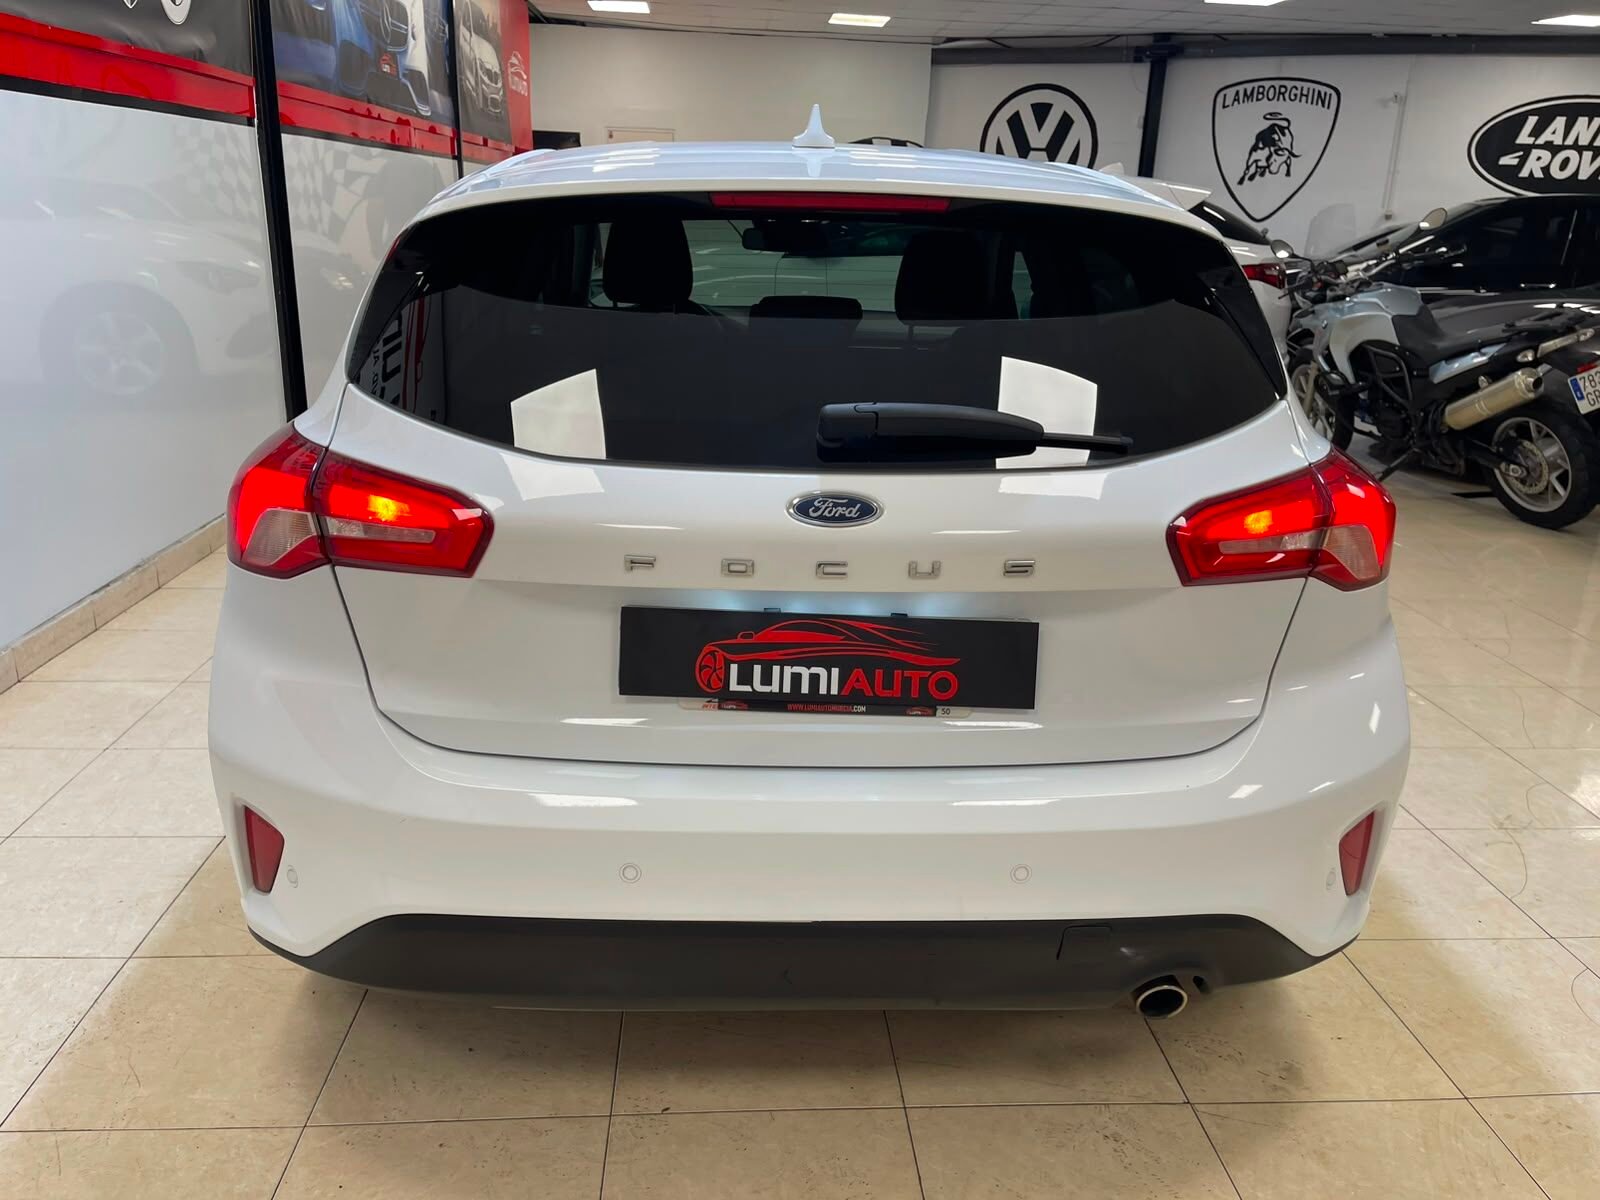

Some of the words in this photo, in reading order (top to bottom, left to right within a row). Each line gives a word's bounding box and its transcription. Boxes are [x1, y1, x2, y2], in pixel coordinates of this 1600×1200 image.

[1222, 85, 1332, 110] LAMBORGHINI
[1515, 115, 1600, 146] LAN
[1518, 148, 1600, 180] ROV
[808, 497, 861, 518] Ford
[624, 554, 1036, 578] FOCUS
[941, 708, 951, 716] 50
